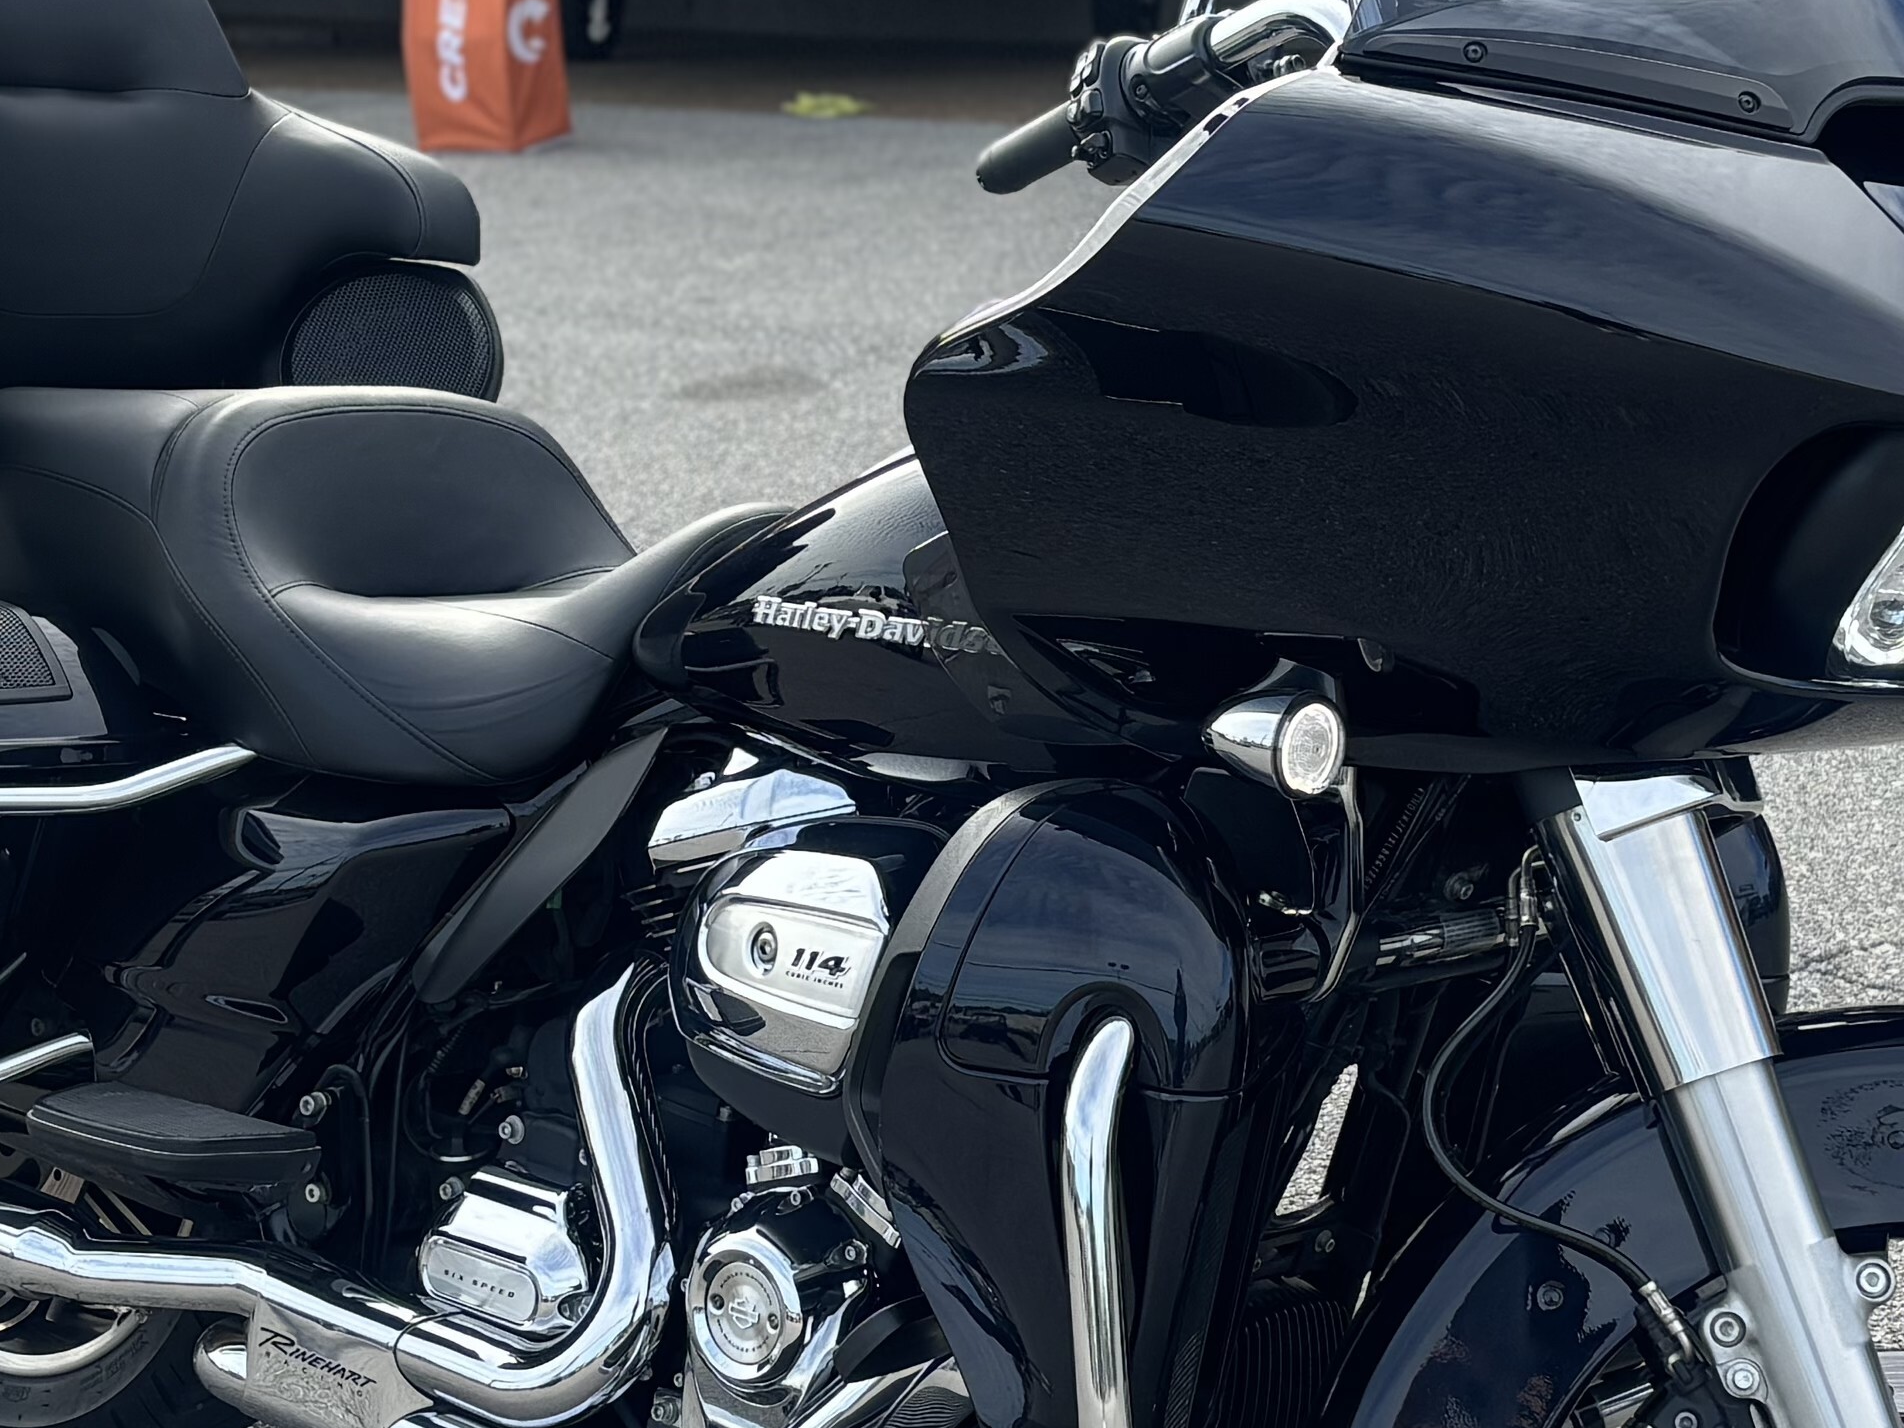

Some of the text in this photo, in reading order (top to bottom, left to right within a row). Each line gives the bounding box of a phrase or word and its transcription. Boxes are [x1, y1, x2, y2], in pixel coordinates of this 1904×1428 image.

[791, 948, 846, 977] 114
[472, 1279, 515, 1298] SPEED
[258, 1326, 378, 1387] RINEHART
